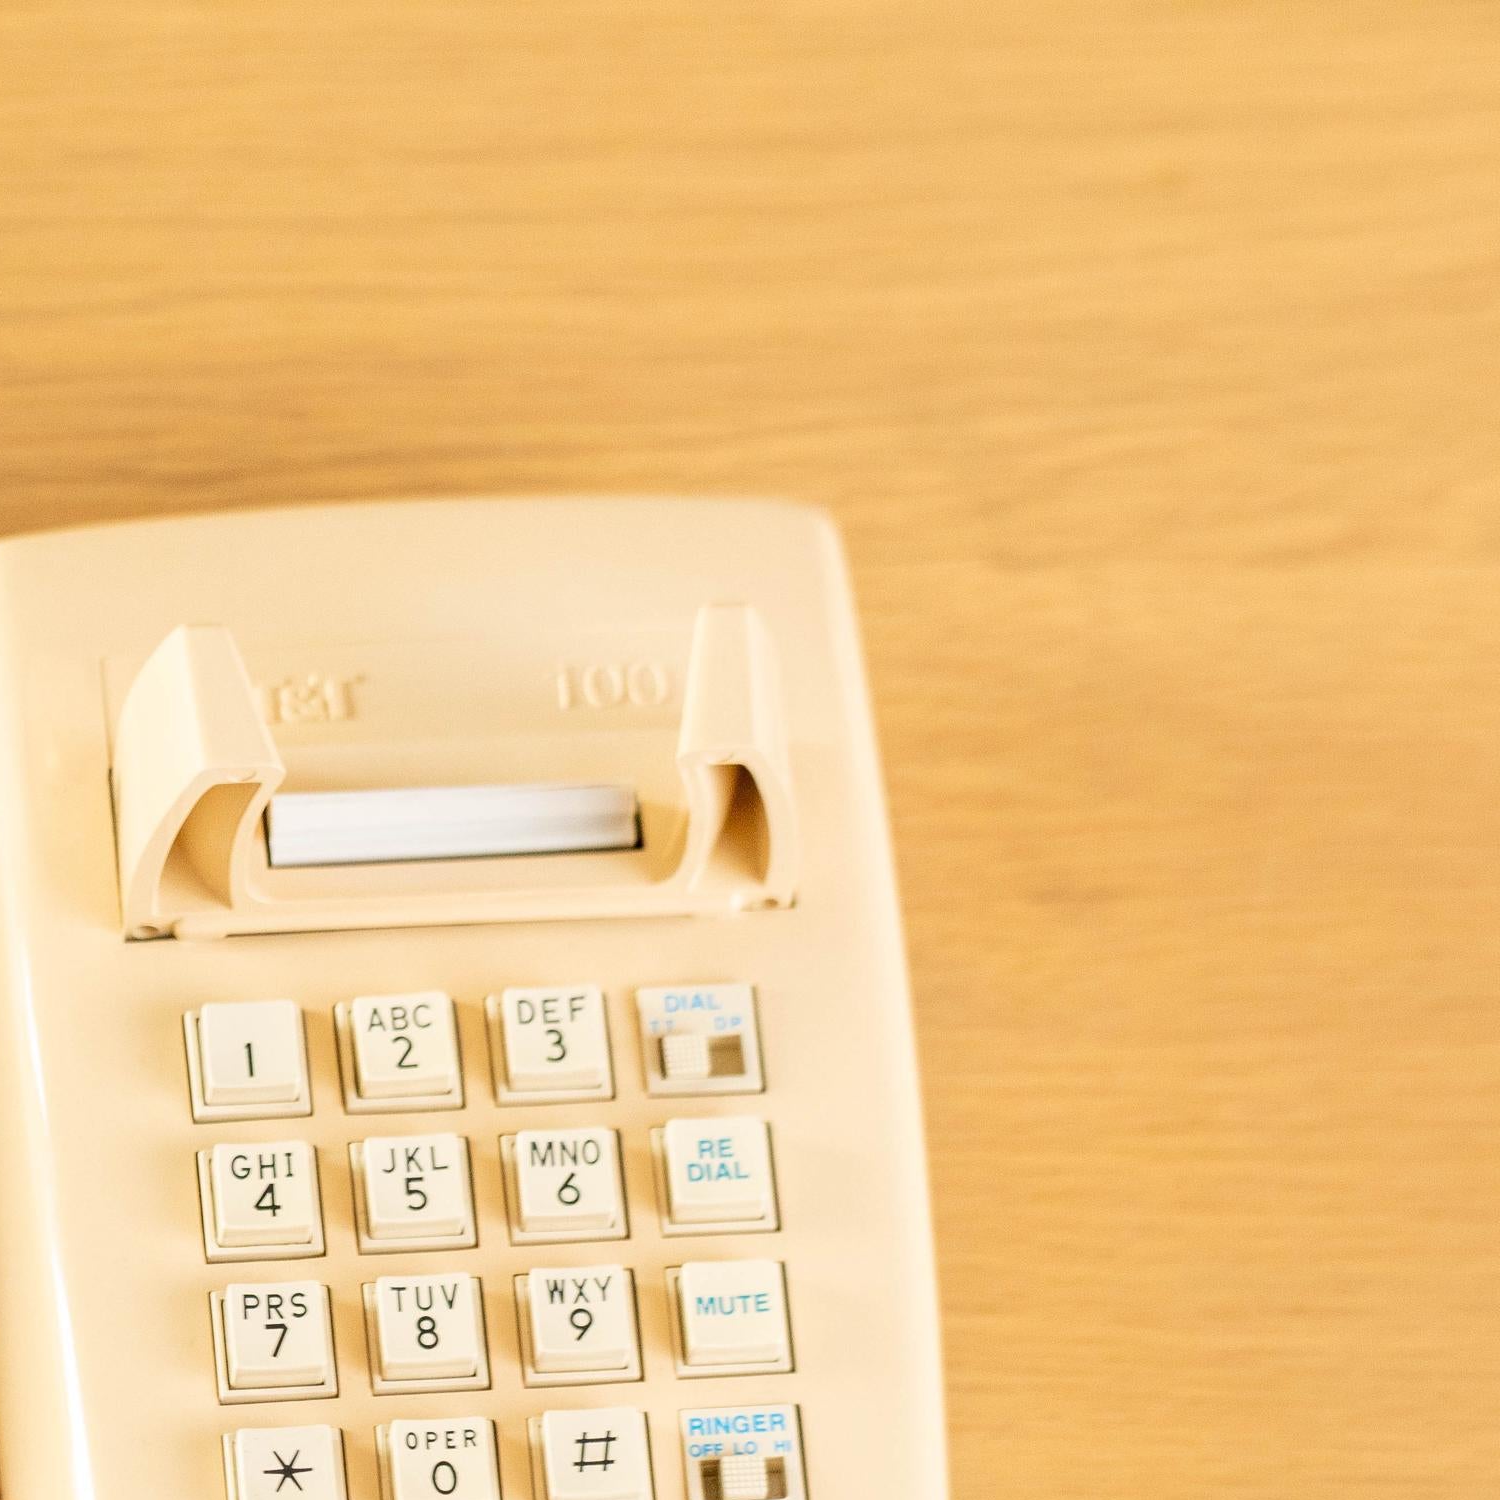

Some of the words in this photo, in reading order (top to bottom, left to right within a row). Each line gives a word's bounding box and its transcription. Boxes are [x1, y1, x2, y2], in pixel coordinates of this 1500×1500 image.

[368, 1003, 432, 1033] ABC
[517, 995, 586, 1025] DEF
[664, 993, 723, 1014] DIAL
[392, 1036, 419, 1069] 2
[545, 1028, 568, 1062] 3
[244, 1042, 254, 1078] 1
[382, 1145, 449, 1174] JKL
[529, 1139, 601, 1168] MNO
[697, 1138, 734, 1159] RE
[231, 1153, 295, 1180] GHI
[686, 1162, 750, 1183] DIAL
[254, 1183, 281, 1217] 4
[404, 1177, 428, 1210] 5
[557, 1172, 581, 1206] 6
[390, 1283, 459, 1312] TUV
[546, 1276, 612, 1305] WXY
[696, 1293, 770, 1316] MUTE
[243, 1293, 308, 1320] PRS
[417, 1316, 439, 1350] 8
[570, 1308, 593, 1341] 9
[265, 1323, 288, 1357] 7
[405, 1429, 477, 1450] OPER
[688, 1413, 787, 1437] RINGER
[689, 1443, 723, 1458] OFF
[733, 1441, 758, 1455] LO
